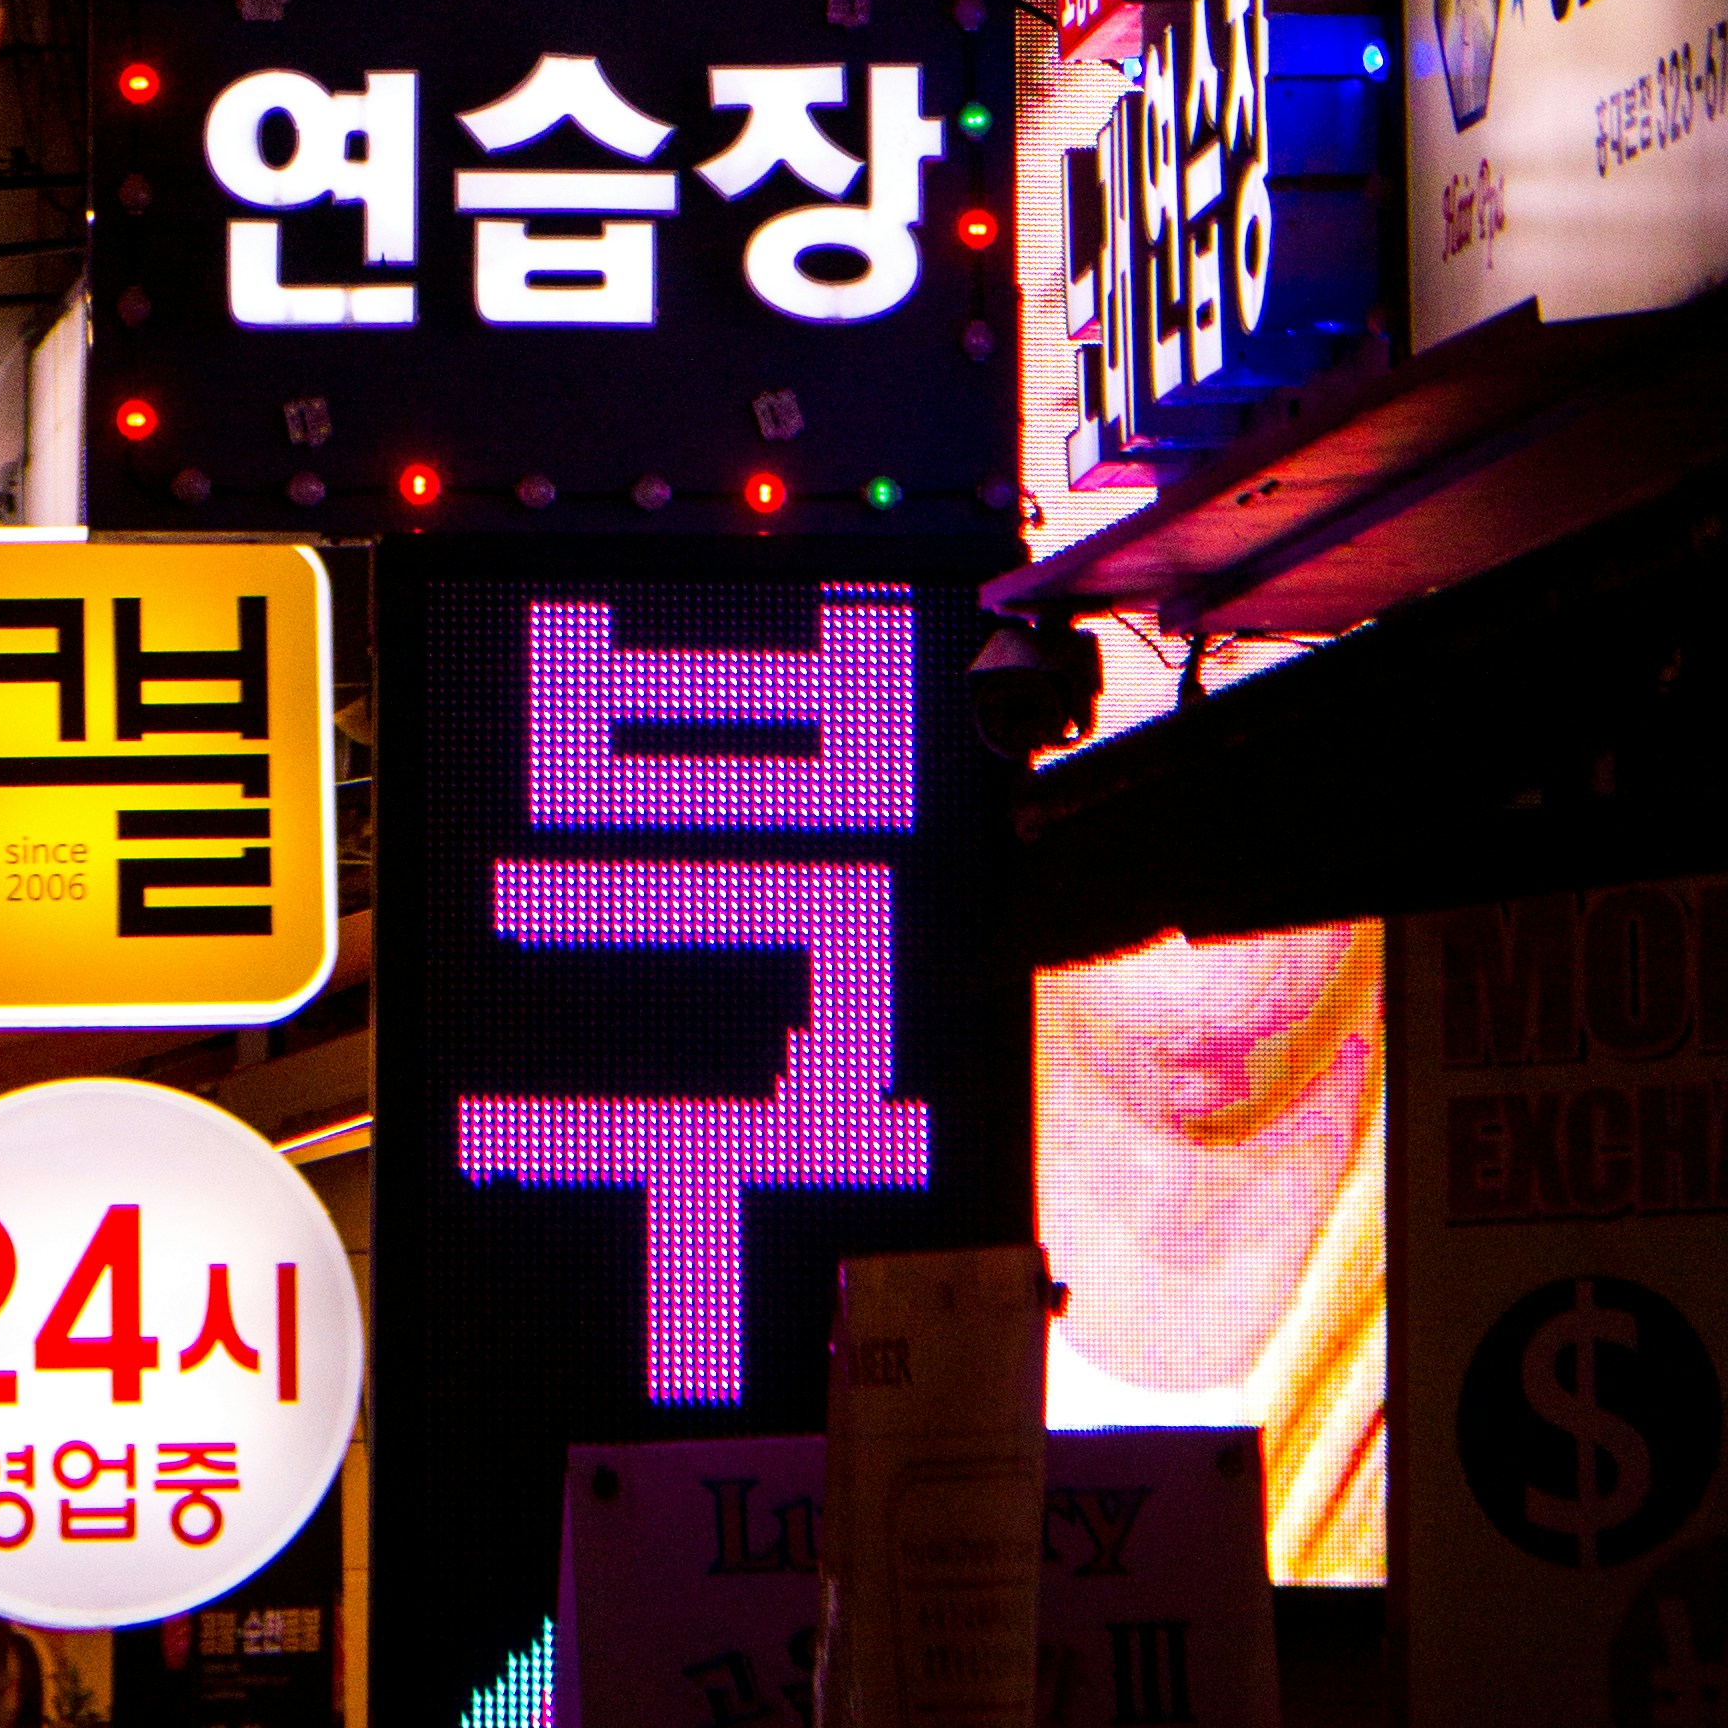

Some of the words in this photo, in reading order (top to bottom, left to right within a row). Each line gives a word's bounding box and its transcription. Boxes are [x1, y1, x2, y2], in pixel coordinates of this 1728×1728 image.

[203, 52, 947, 328] 연습장
[4, 836, 89, 866] since
[4, 872, 89, 902] 2006
[1445, 1081, 1728, 1226] EXCH
